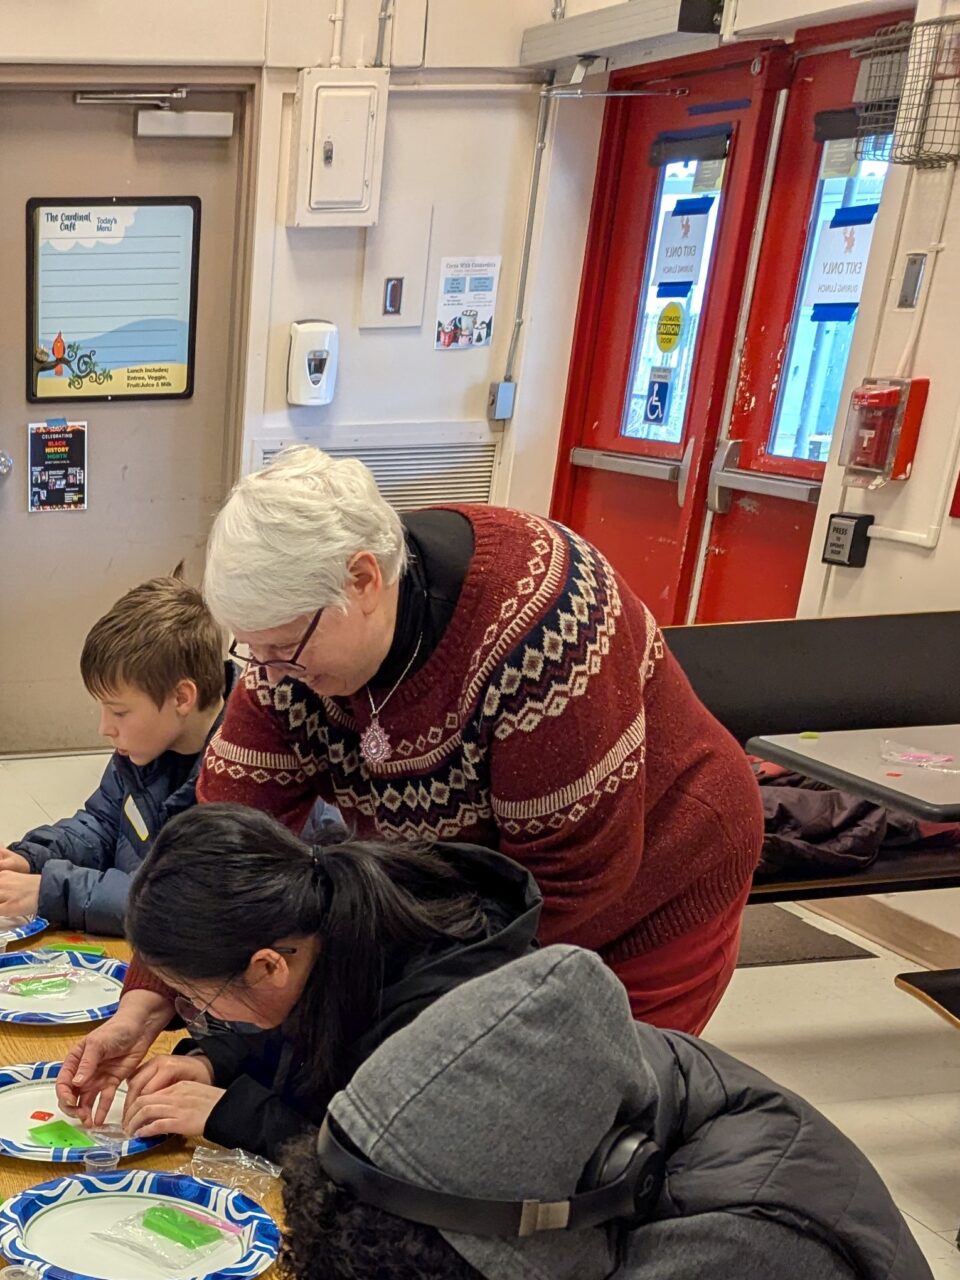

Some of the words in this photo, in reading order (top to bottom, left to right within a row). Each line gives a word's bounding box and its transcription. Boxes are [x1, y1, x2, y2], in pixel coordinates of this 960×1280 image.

[45, 213, 59, 222] The
[60, 212, 92, 222] Cardinal
[97, 217, 117, 225] Today's
[657, 324, 680, 335] CAUTION
[832, 526, 848, 536] PRESS
